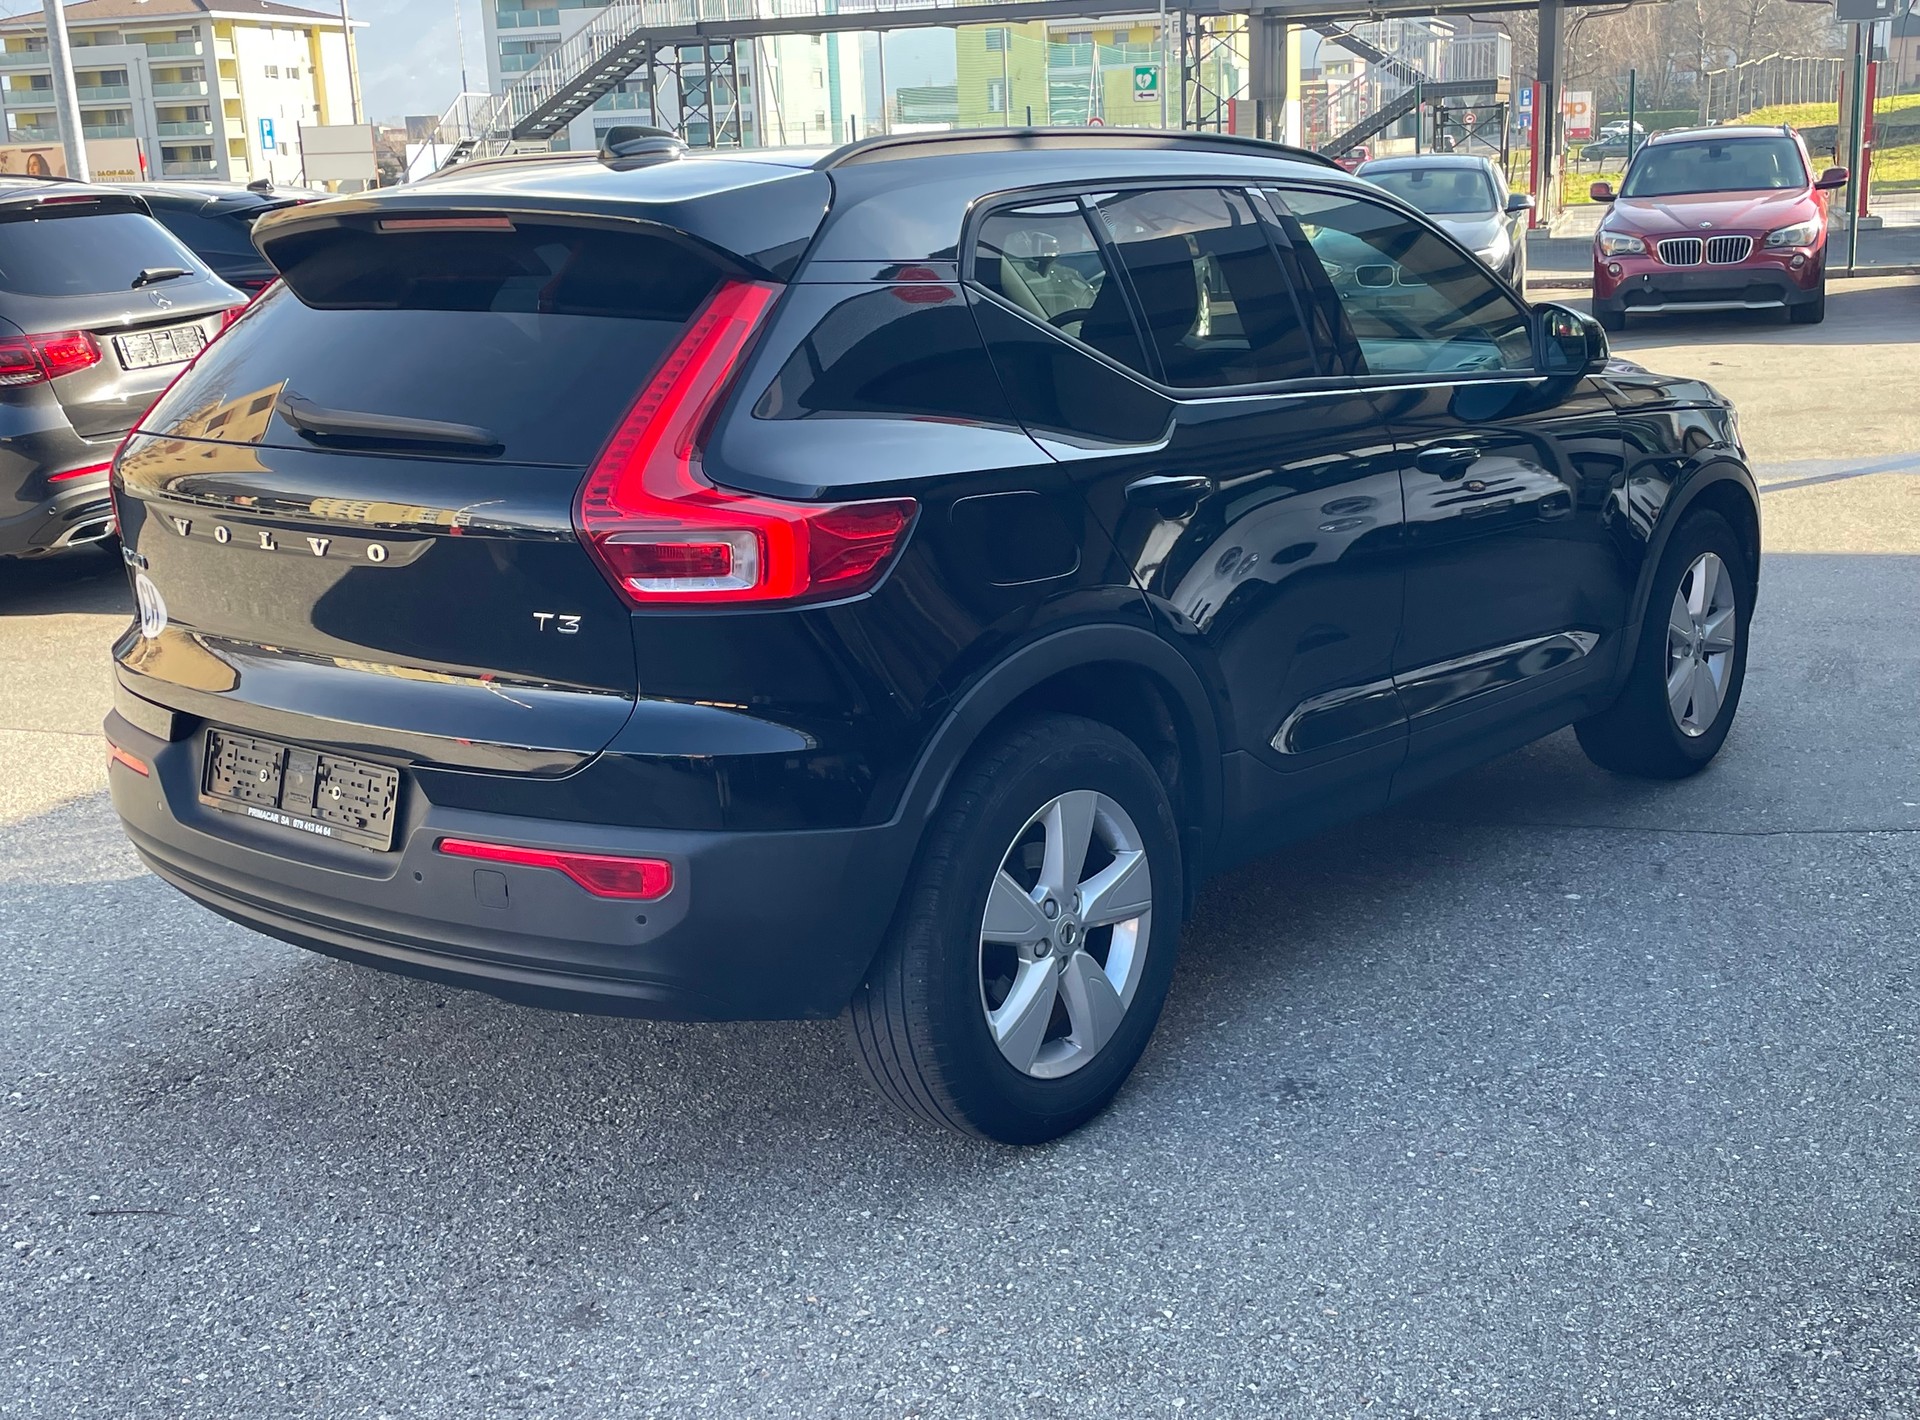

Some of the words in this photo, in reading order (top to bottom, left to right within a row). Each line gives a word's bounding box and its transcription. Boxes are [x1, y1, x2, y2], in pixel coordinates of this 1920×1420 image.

[172, 516, 390, 563] VOLVO
[532, 612, 582, 635] T3
[247, 806, 279, 823] PRIMACAR
[280, 815, 290, 826] SA
[292, 818, 304, 830] 079
[304, 821, 315, 833] 413
